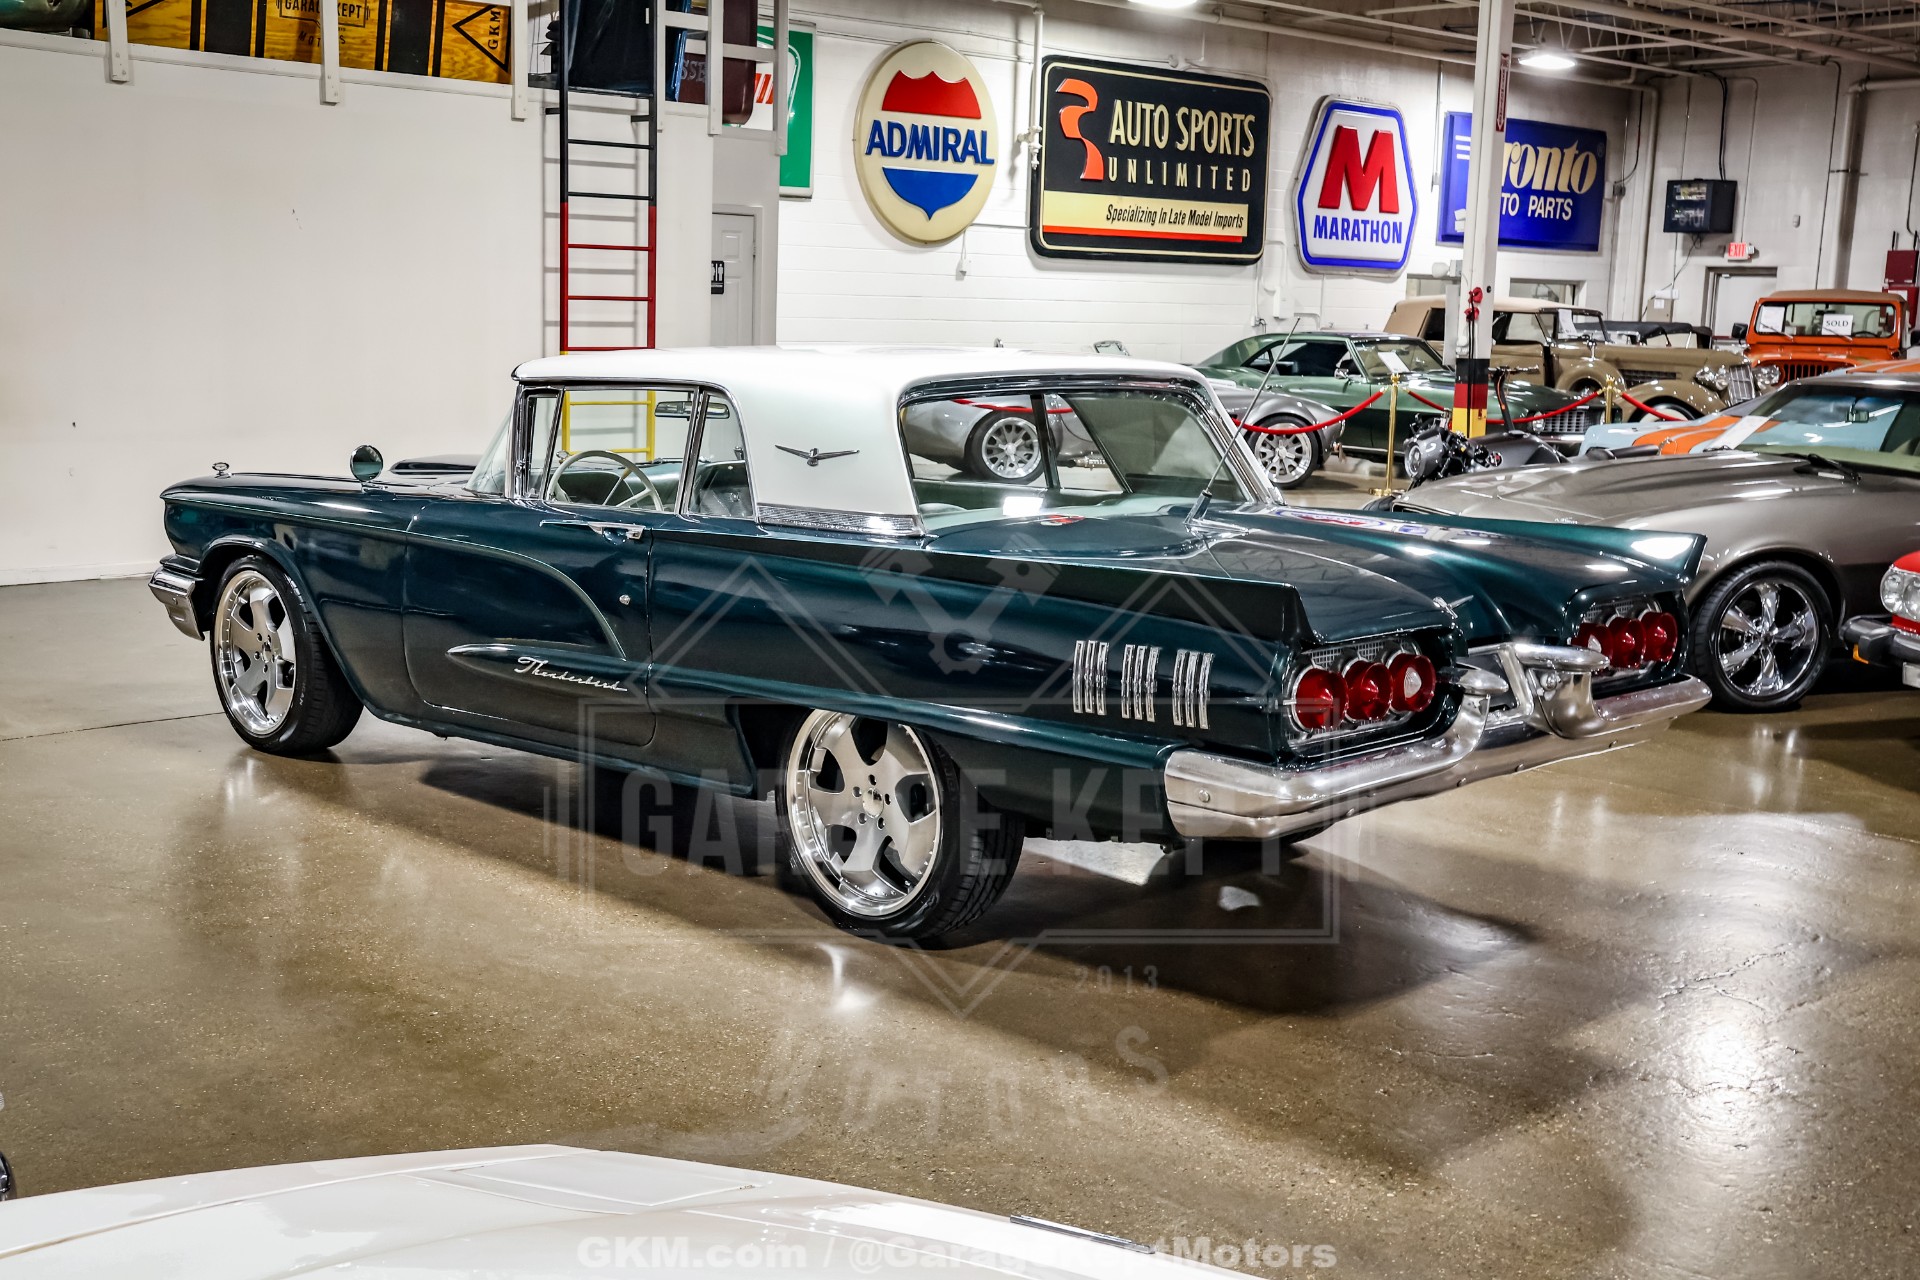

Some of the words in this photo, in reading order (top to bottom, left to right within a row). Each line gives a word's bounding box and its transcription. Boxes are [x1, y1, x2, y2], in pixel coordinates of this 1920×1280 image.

[487, 9, 502, 50] GKM
[865, 119, 995, 165] ADMIRAL
[1109, 99, 1170, 149] AUTO
[1175, 106, 1256, 158] SPORTS
[1108, 156, 1251, 192] UNLIMITED
[1317, 124, 1400, 214] M
[1501, 139, 1598, 195] ronto
[1106, 203, 1157, 226] Specializing
[1158, 207, 1168, 224] In
[1168, 208, 1187, 226] Late
[1187, 209, 1213, 227] Model
[1213, 211, 1244, 230] Imports
[1527, 195, 1573, 221] PARTS
[1313, 214, 1403, 244] MARATHON
[1727, 242, 1747, 258] EXIT
[1825, 320, 1849, 328] SOLD
